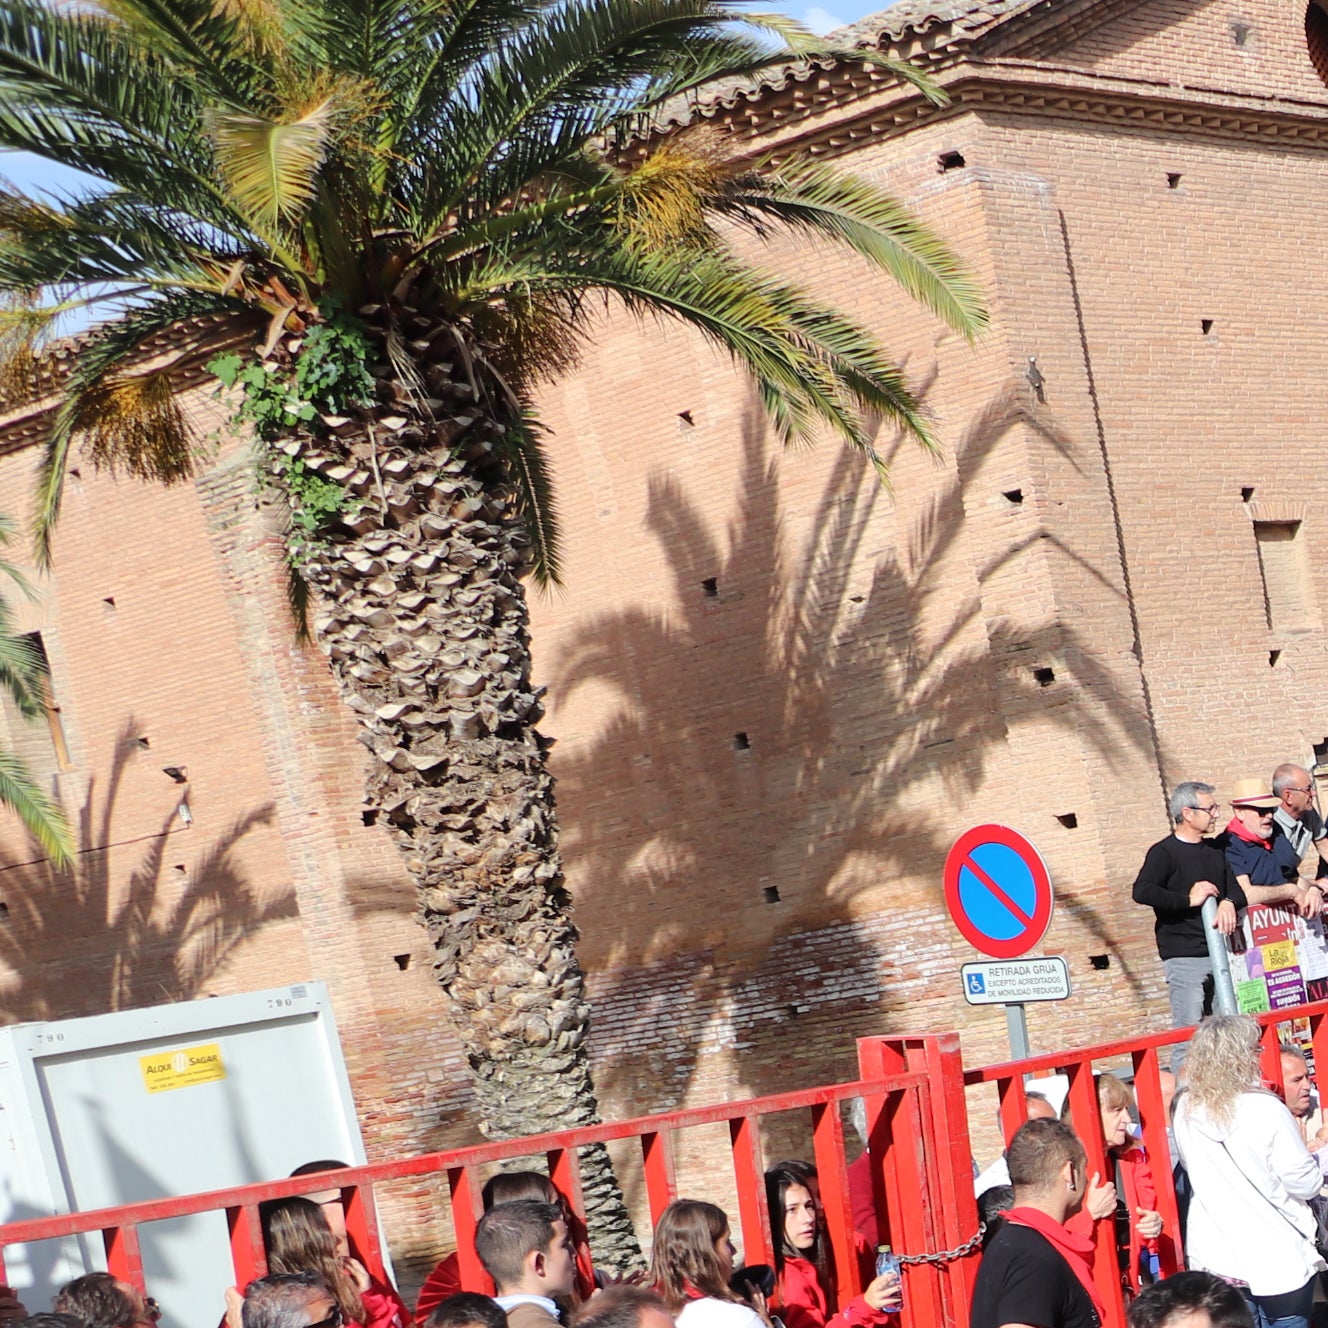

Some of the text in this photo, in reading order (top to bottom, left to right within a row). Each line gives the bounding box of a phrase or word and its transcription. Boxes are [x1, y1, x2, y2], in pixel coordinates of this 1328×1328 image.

[988, 965, 1031, 977] RETIRADA
[988, 976, 1062, 988] EXCEPTO ACREDITADOS
[987, 985, 1066, 998] DE MOVILIDAD REDUCIDA
[187, 1053, 218, 1067] SAGAR
